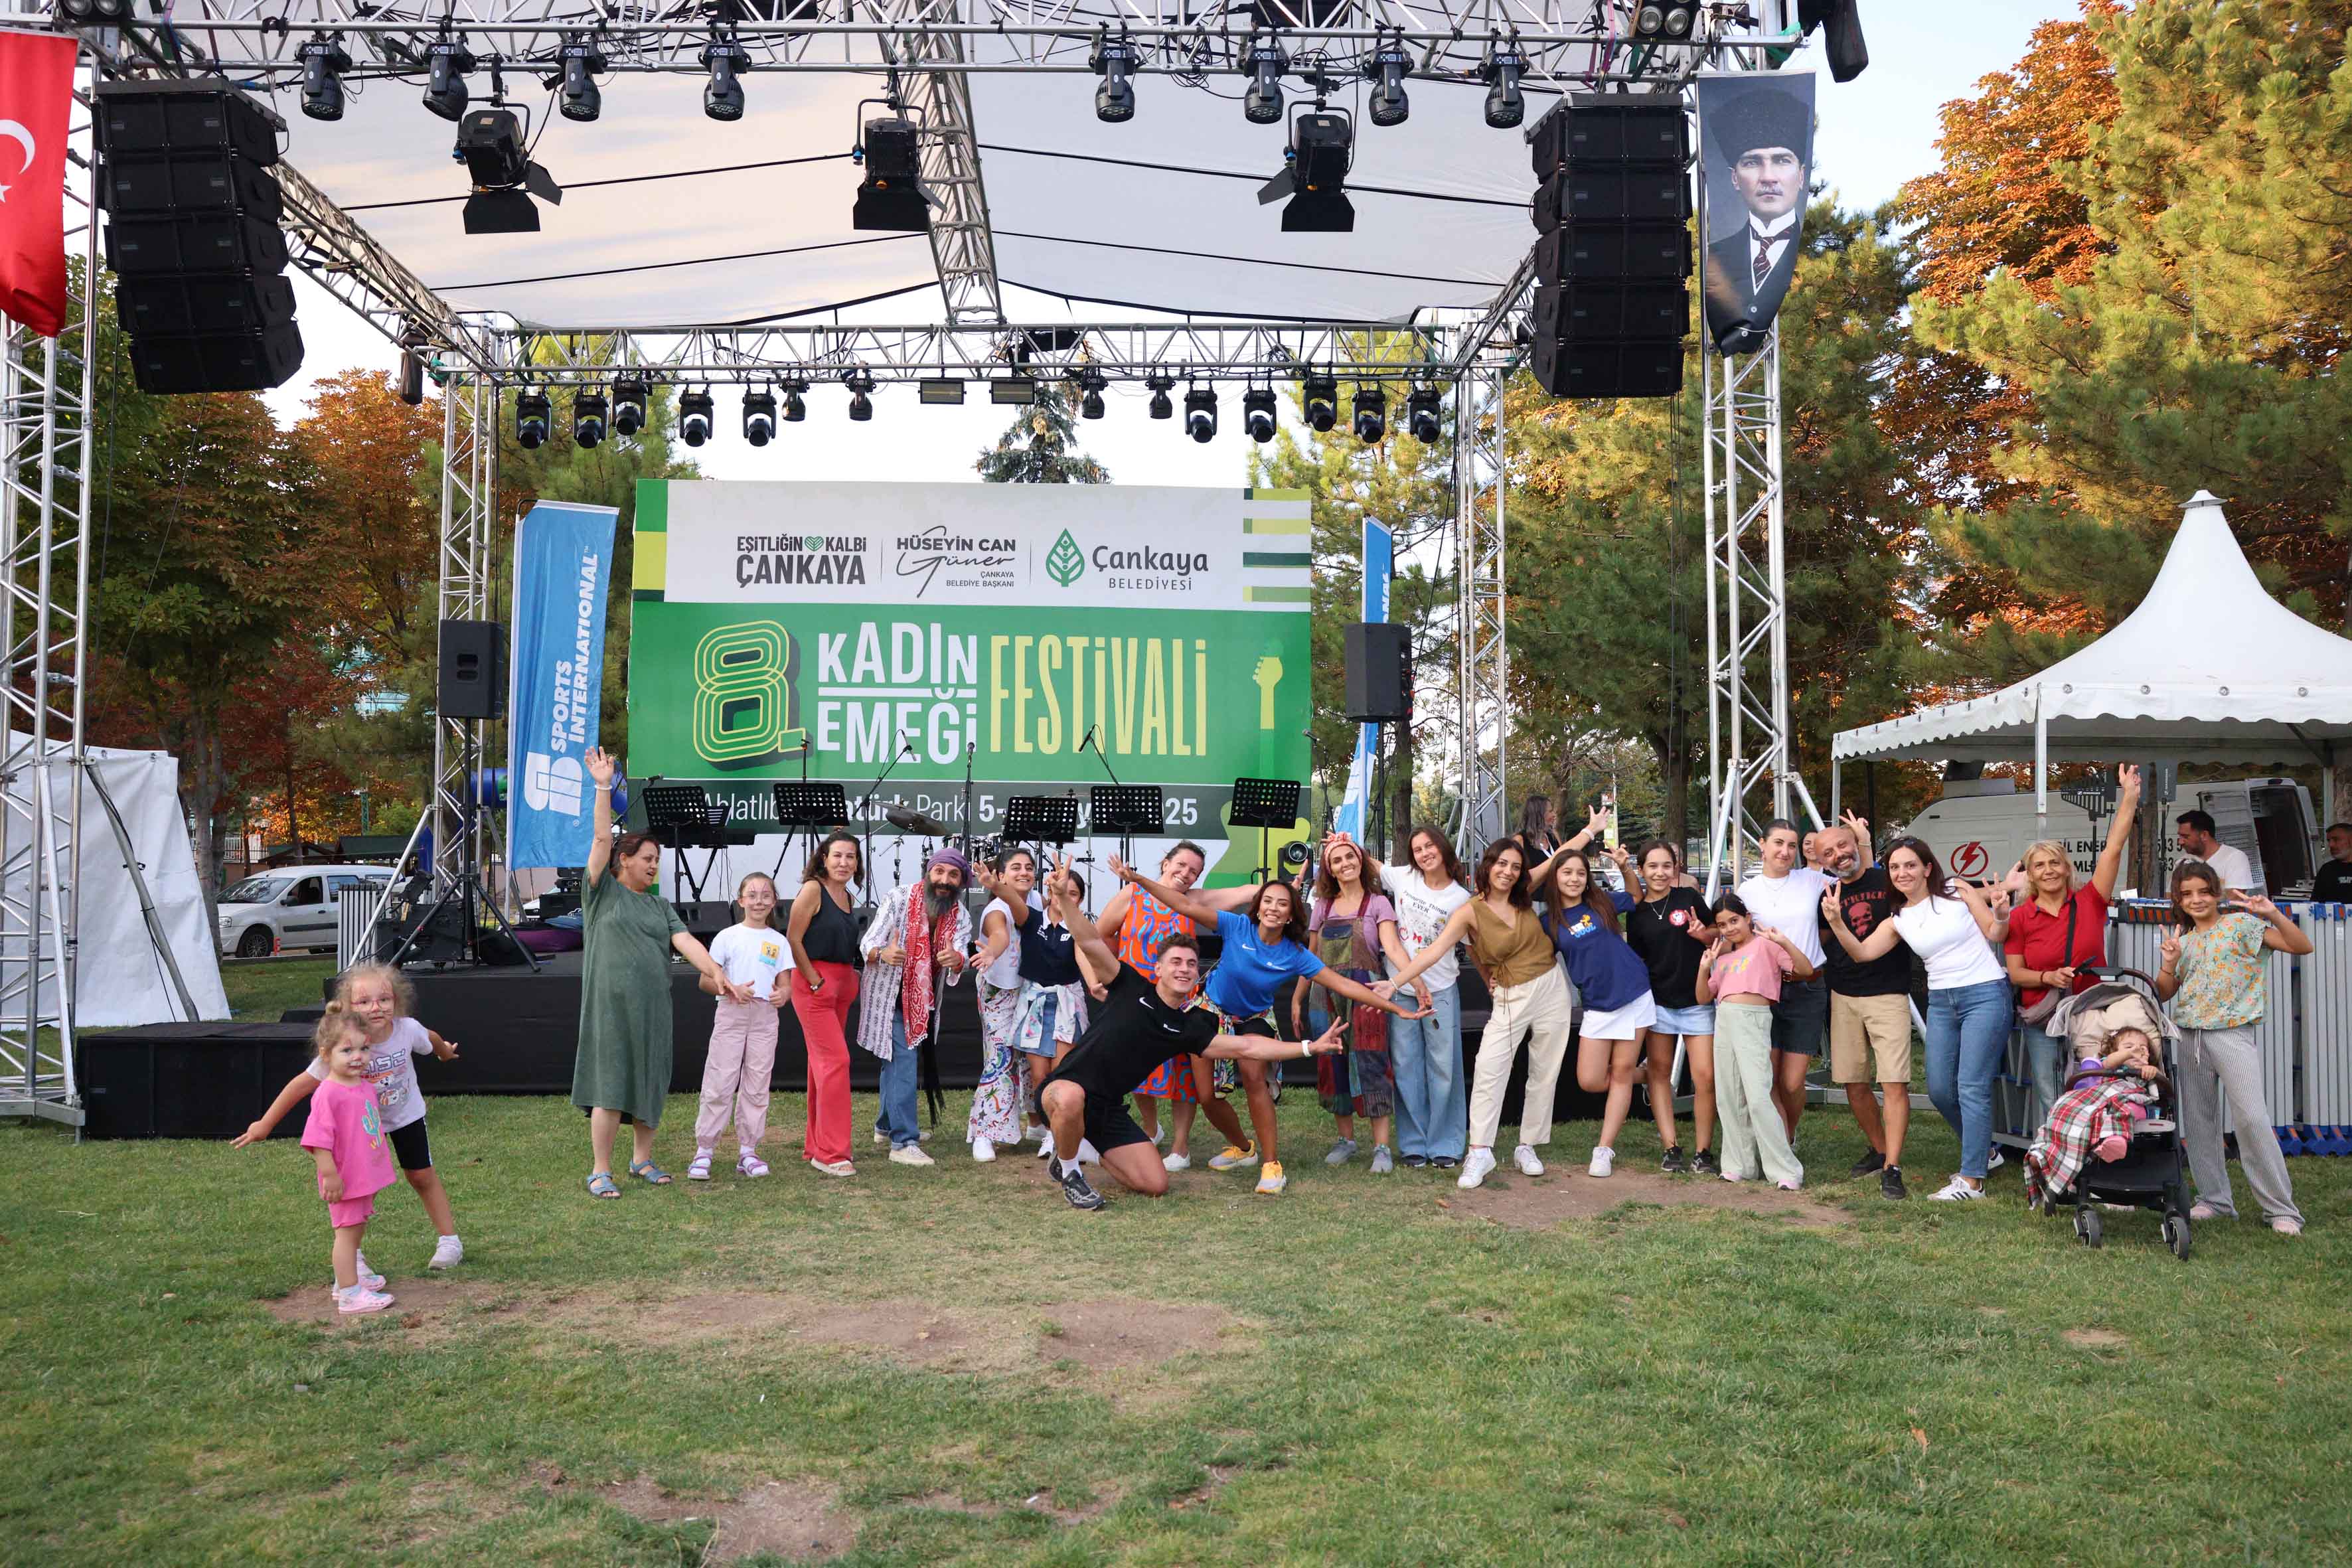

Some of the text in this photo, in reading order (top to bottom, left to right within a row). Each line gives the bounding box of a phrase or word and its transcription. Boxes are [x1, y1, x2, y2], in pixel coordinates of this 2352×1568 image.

[896, 534, 1016, 552] HÜSEYİN CAN
[736, 554, 866, 588] ÇANKAYA
[896, 526, 1015, 598] Güner
[980, 571, 1014, 580] ÇANKAYA
[1092, 545, 1209, 576] Çankaya
[946, 579, 1014, 589] BELEDİYE BAŞKANI
[1109, 576, 1192, 590] BELEDİYESİ
[568, 554, 598, 744] INTERNATIONAL
[818, 621, 977, 684] KADIN
[551, 660, 572, 753] SPORTS
[1412, 902, 1429, 913] EVER
